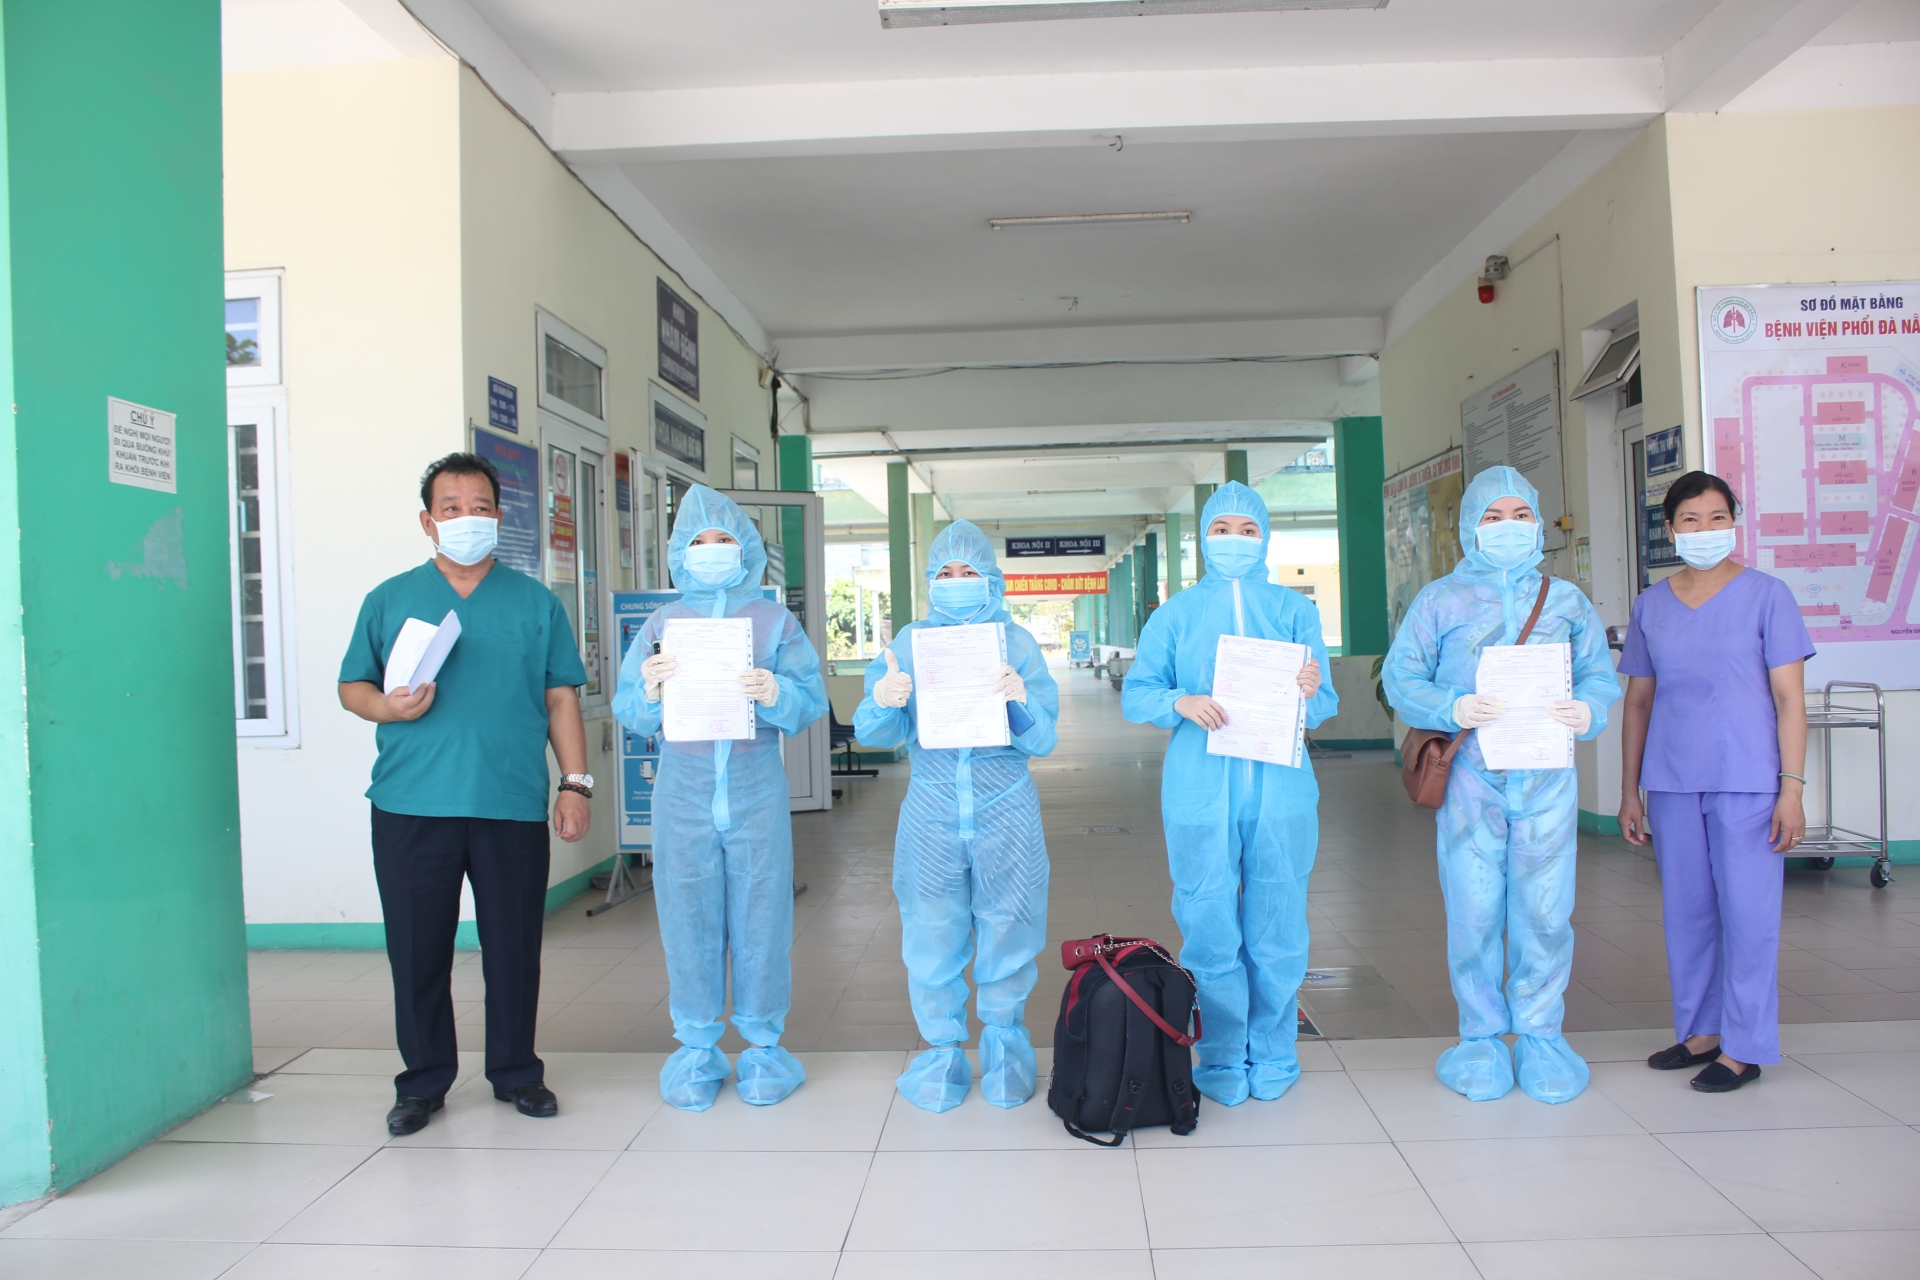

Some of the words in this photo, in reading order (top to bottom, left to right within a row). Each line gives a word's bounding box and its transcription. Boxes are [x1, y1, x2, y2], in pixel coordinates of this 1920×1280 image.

[1801, 299, 1817, 312] SƠ
[1820, 295, 1837, 311] ĐỒ
[1840, 296, 1866, 313] MẶT
[1870, 293, 1904, 310] BẰNG
[1765, 321, 1802, 341] BỆNH
[1806, 320, 1840, 340] VIỆN
[1842, 315, 1874, 336] PHỔI
[1878, 316, 1897, 335] ĐÀ
[131, 410, 147, 424] CHÚ
[150, 413, 154, 426] Ý
[122, 439, 135, 448] QUA
[115, 462, 124, 471] RA
[141, 466, 157, 477] BỆNH
[158, 470, 171, 481] VIỆN
[160, 460, 169, 469] KHI
[1032, 540, 1043, 550] NỘI
[1080, 539, 1091, 548] NỘI
[1015, 575, 1028, 592] CHIẾN
[1029, 575, 1043, 591] THẮNG
[1045, 578, 1057, 591] COVID
[1061, 574, 1074, 590] CHẤM
[1075, 576, 1084, 590] DỨT
[1085, 575, 1096, 593] BỆNH
[1097, 577, 1106, 590] LAO
